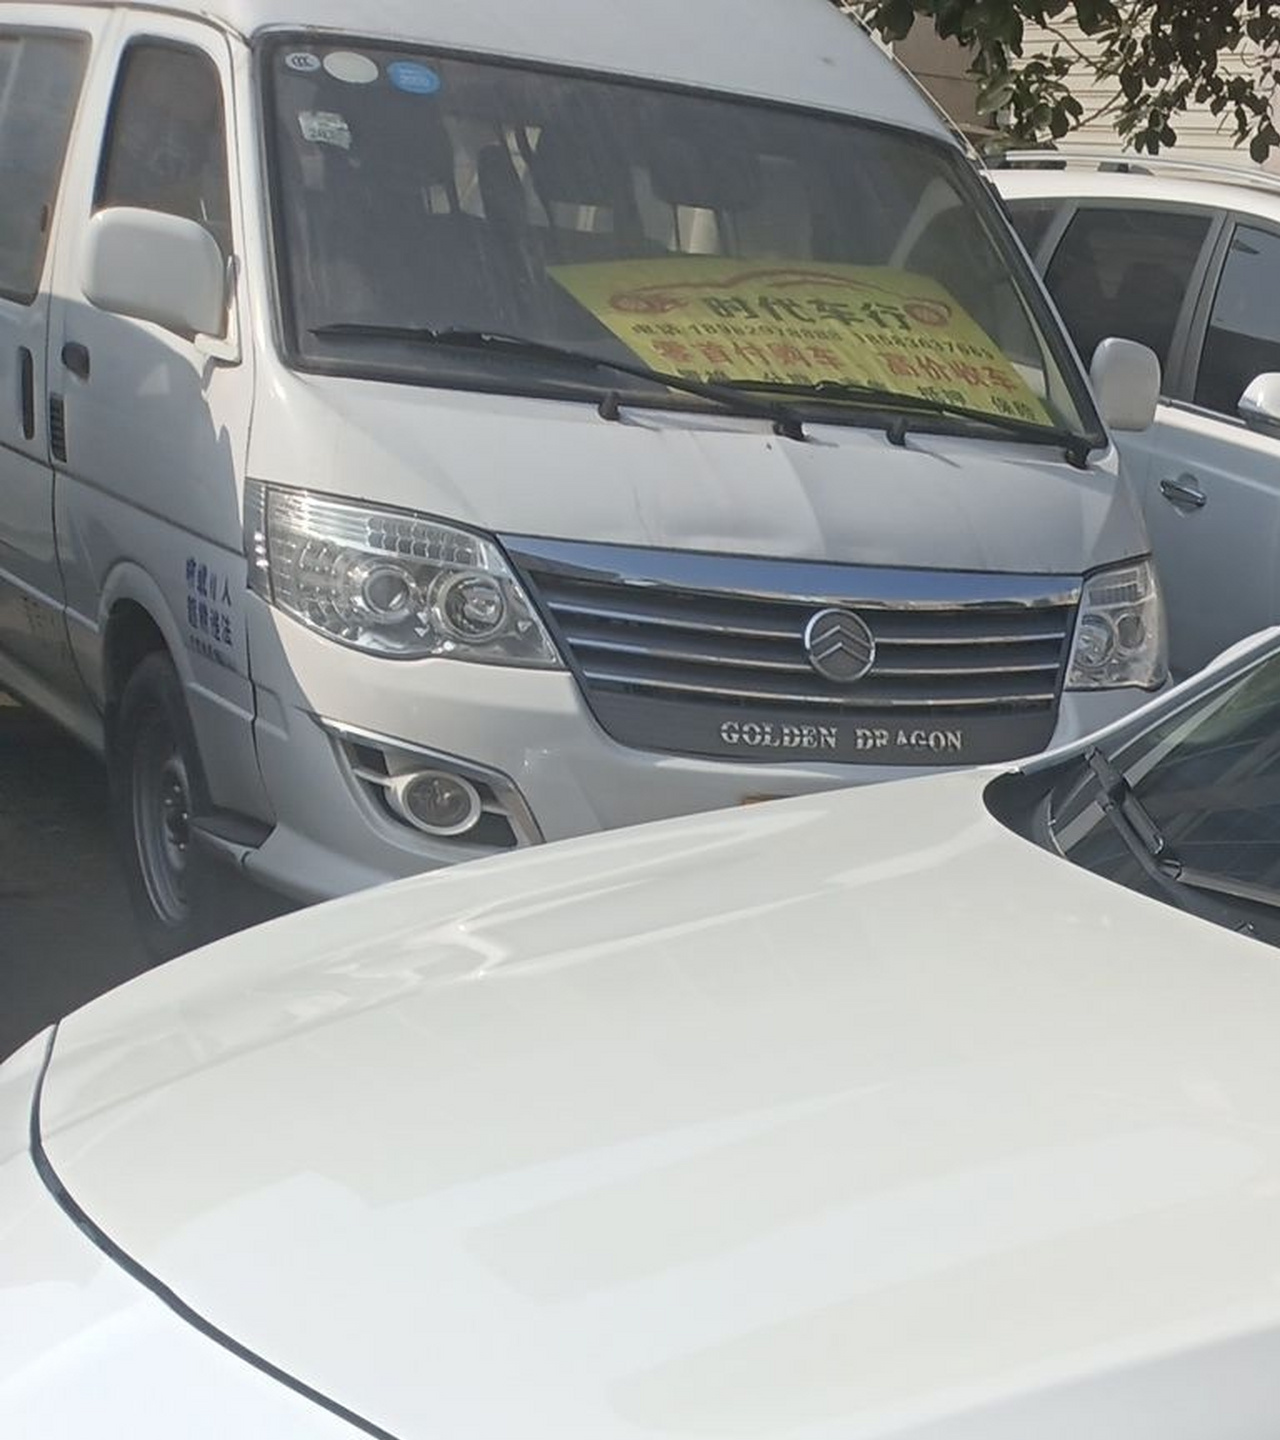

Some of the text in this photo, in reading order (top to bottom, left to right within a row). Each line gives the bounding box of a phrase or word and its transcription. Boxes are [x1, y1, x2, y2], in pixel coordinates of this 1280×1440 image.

[703, 294, 912, 331] 时代车行
[719, 720, 944, 751] GOLDEN DRAGON
